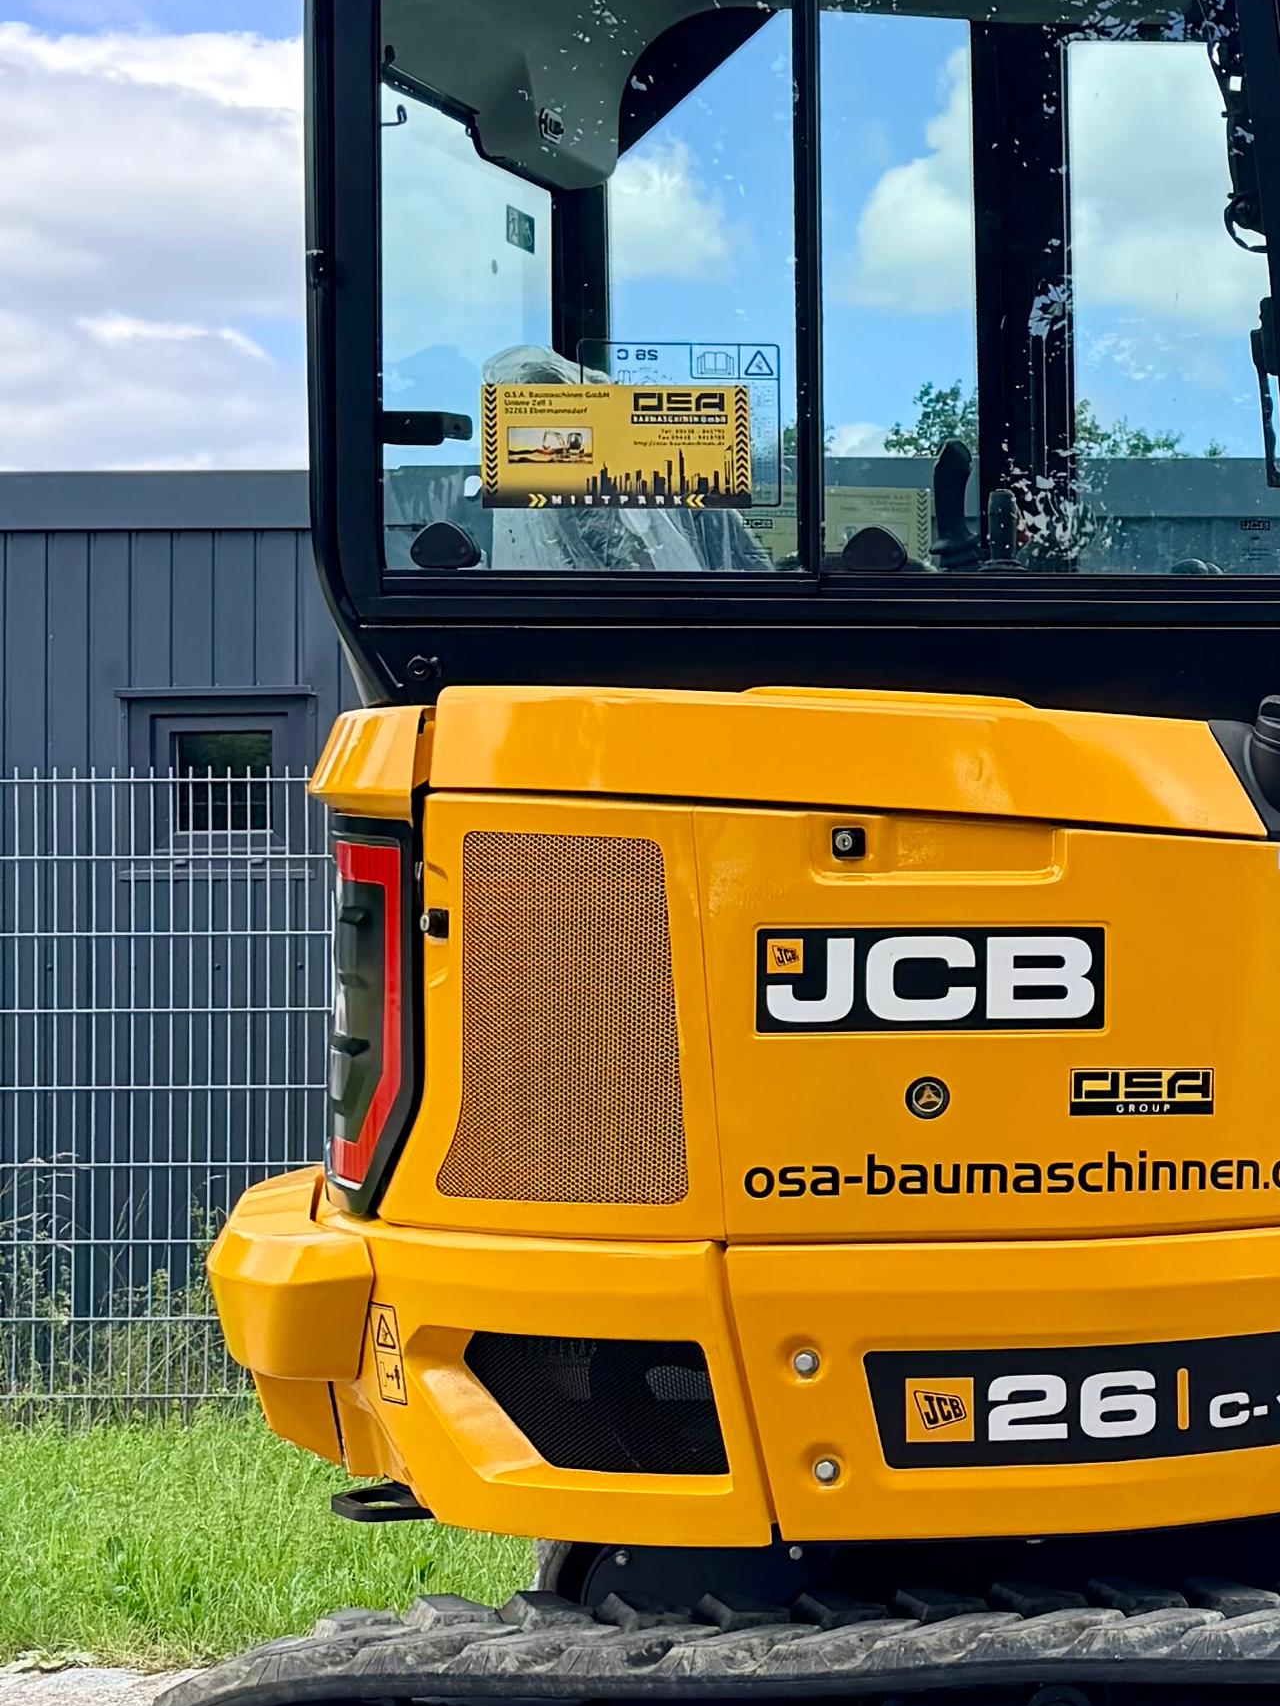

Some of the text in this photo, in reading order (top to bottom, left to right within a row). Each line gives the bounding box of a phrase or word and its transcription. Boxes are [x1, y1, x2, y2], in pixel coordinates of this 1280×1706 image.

[766, 936, 1095, 1022] JCB
[1073, 1071, 1211, 1100] OSA
[1116, 1103, 1171, 1113] GROUP
[923, 1392, 964, 1428] JCB
[988, 1370, 1156, 1441] 26
